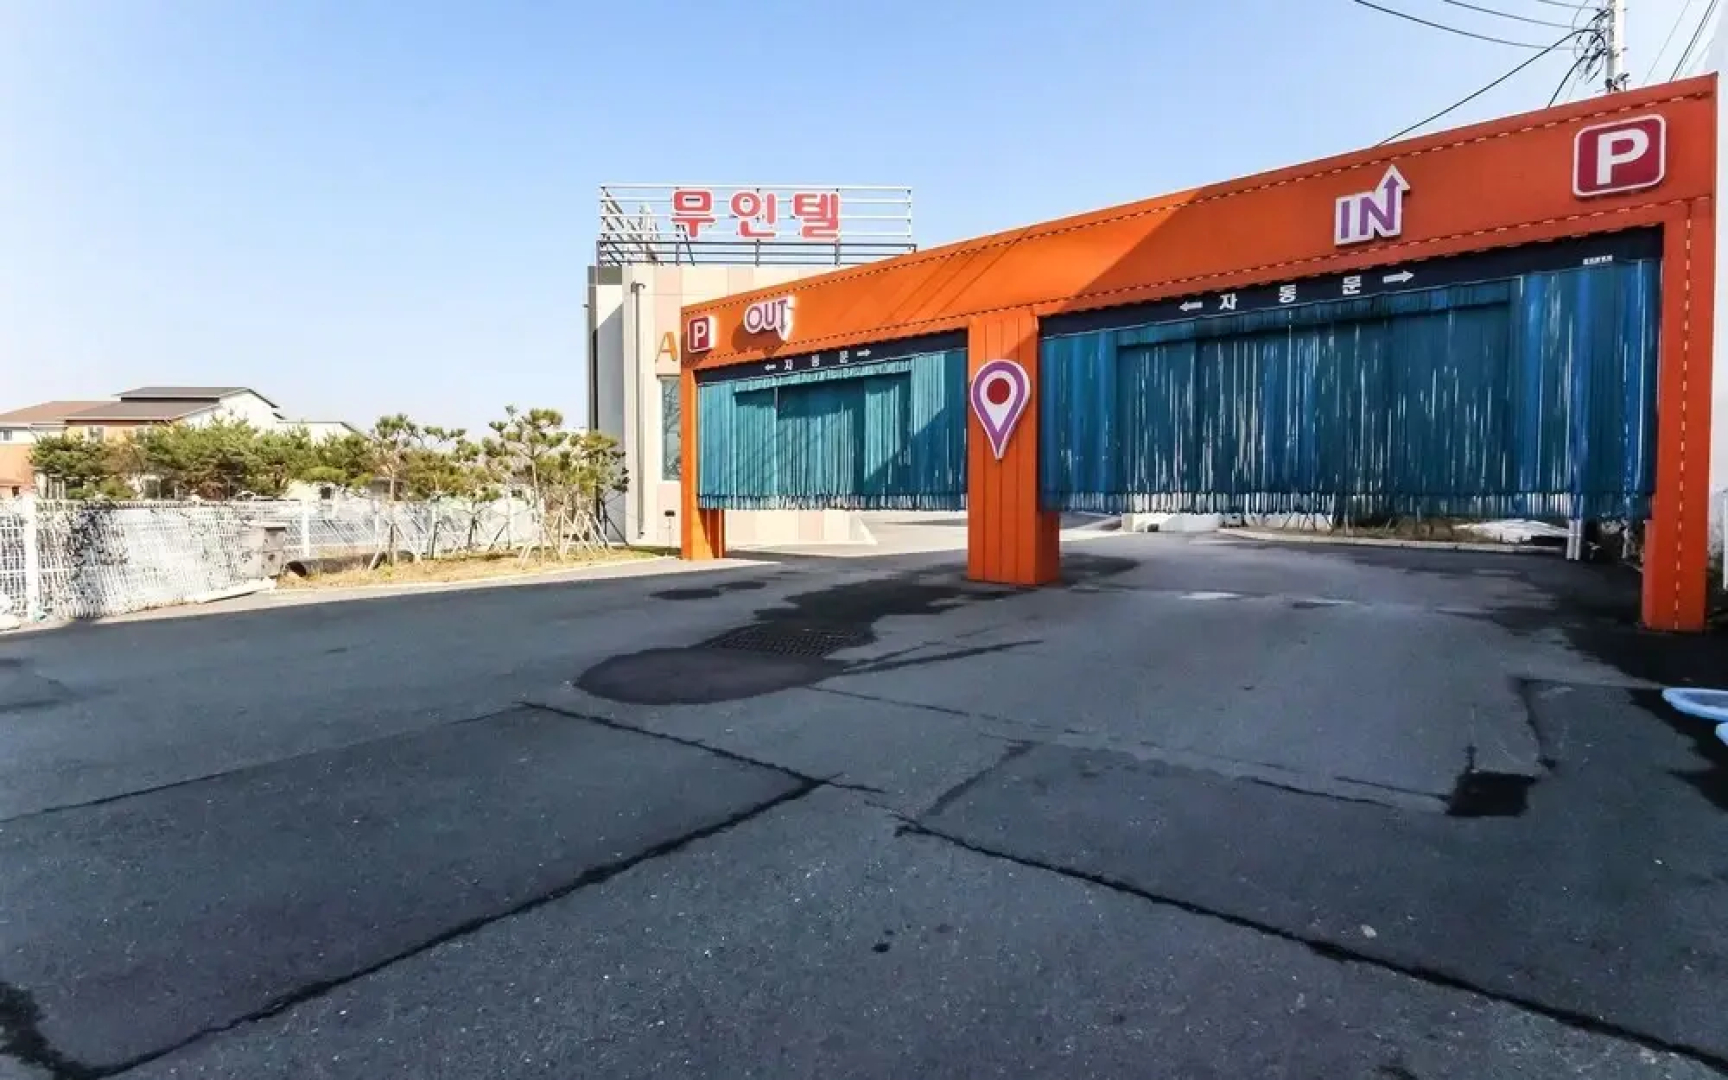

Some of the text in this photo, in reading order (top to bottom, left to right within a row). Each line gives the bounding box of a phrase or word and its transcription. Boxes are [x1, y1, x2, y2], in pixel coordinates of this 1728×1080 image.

[1597, 127, 1650, 185] P
[671, 189, 840, 240] 무인텔
[1337, 172, 1402, 242] IN
[1219, 275, 1362, 311] 자동문
[745, 297, 791, 337] OUT
[655, 331, 678, 362] A
